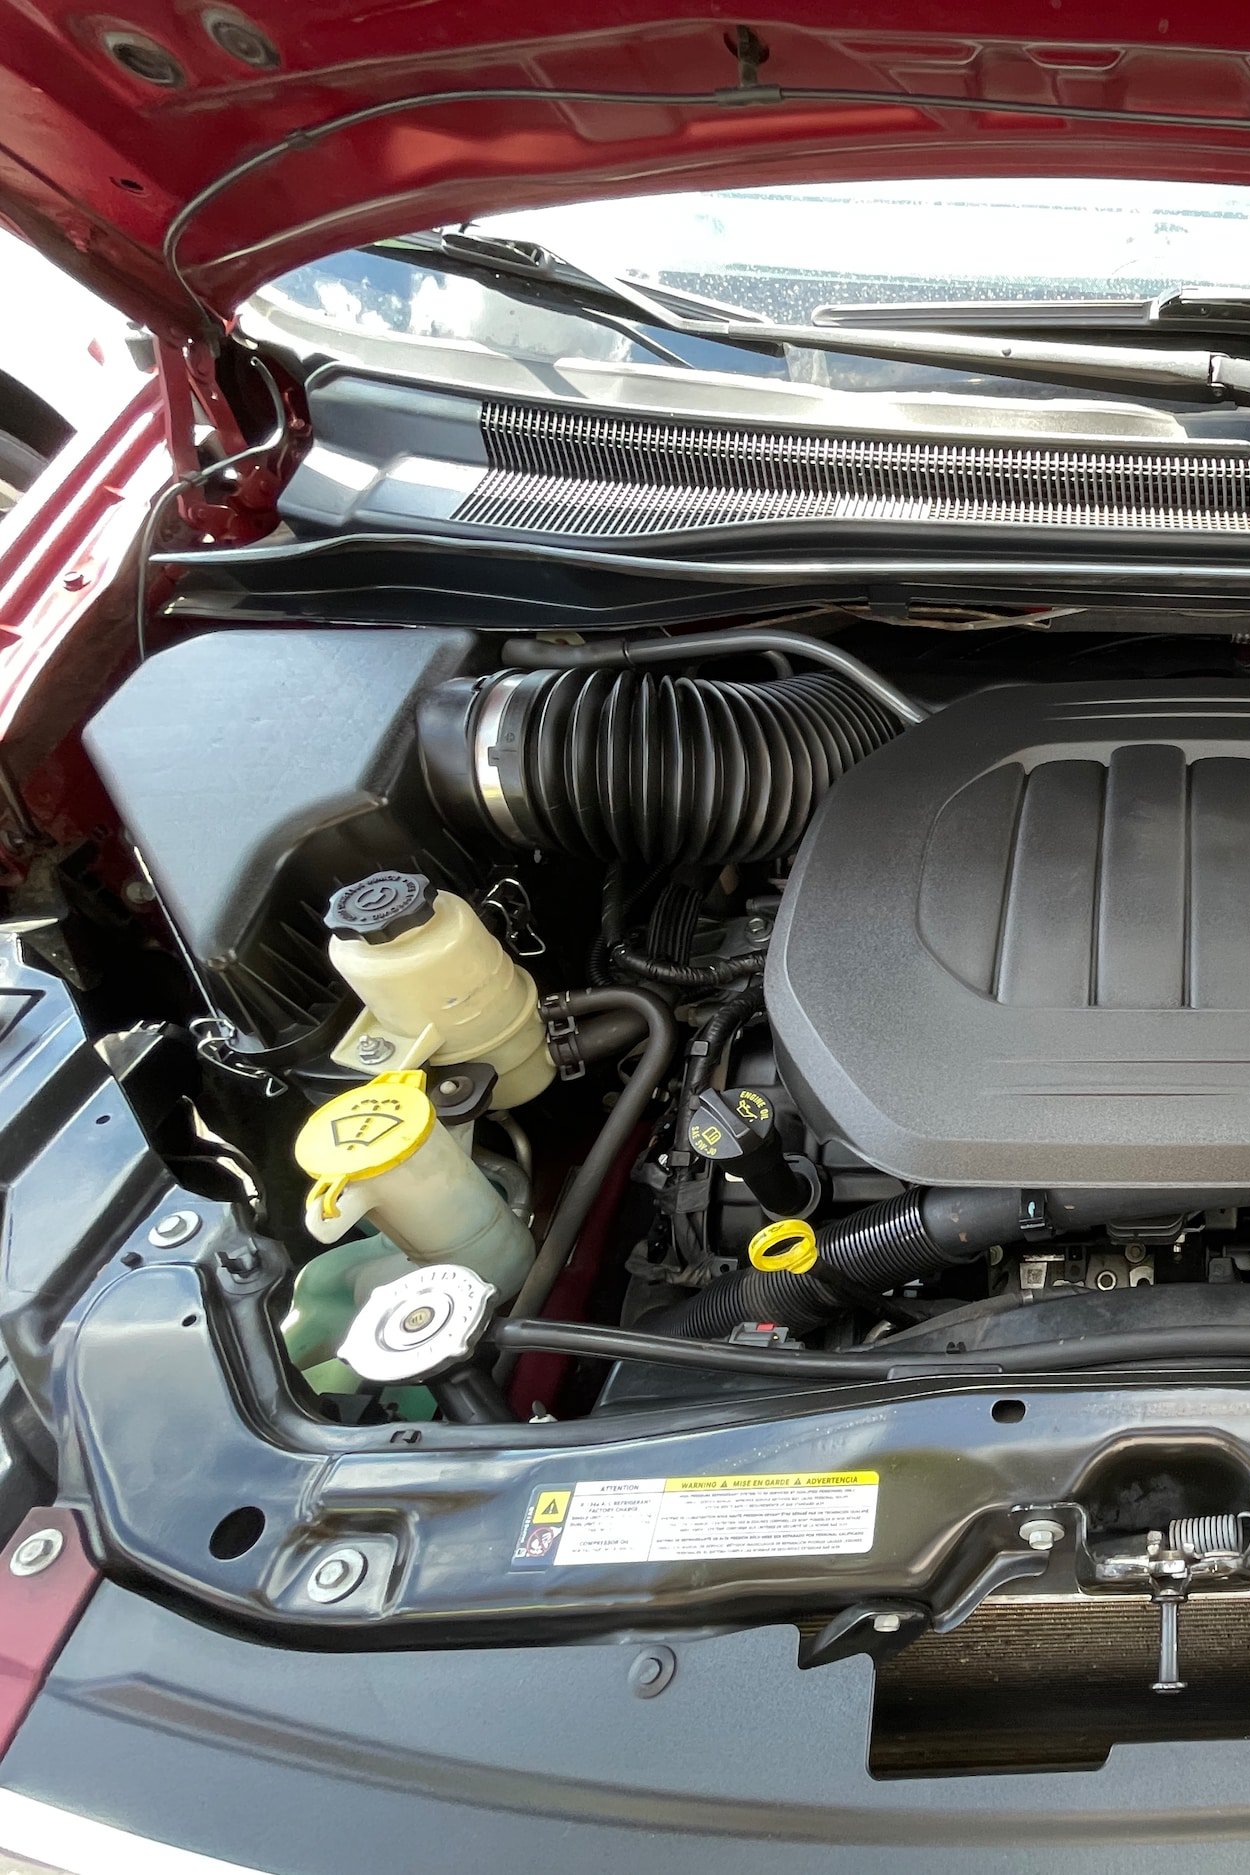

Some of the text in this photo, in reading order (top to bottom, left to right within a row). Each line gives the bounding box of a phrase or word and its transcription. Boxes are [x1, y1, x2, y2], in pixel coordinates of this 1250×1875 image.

[740, 1091, 769, 1120] ENGINE OIL
[691, 1125, 717, 1156] SAE 5W-30
[681, 1480, 717, 1489] WARNING
[752, 1479, 763, 1487] EN
[765, 1478, 790, 1486] GARDE
[806, 1476, 858, 1485] ADVERTENCIA
[600, 1484, 639, 1492] ATTENTION
